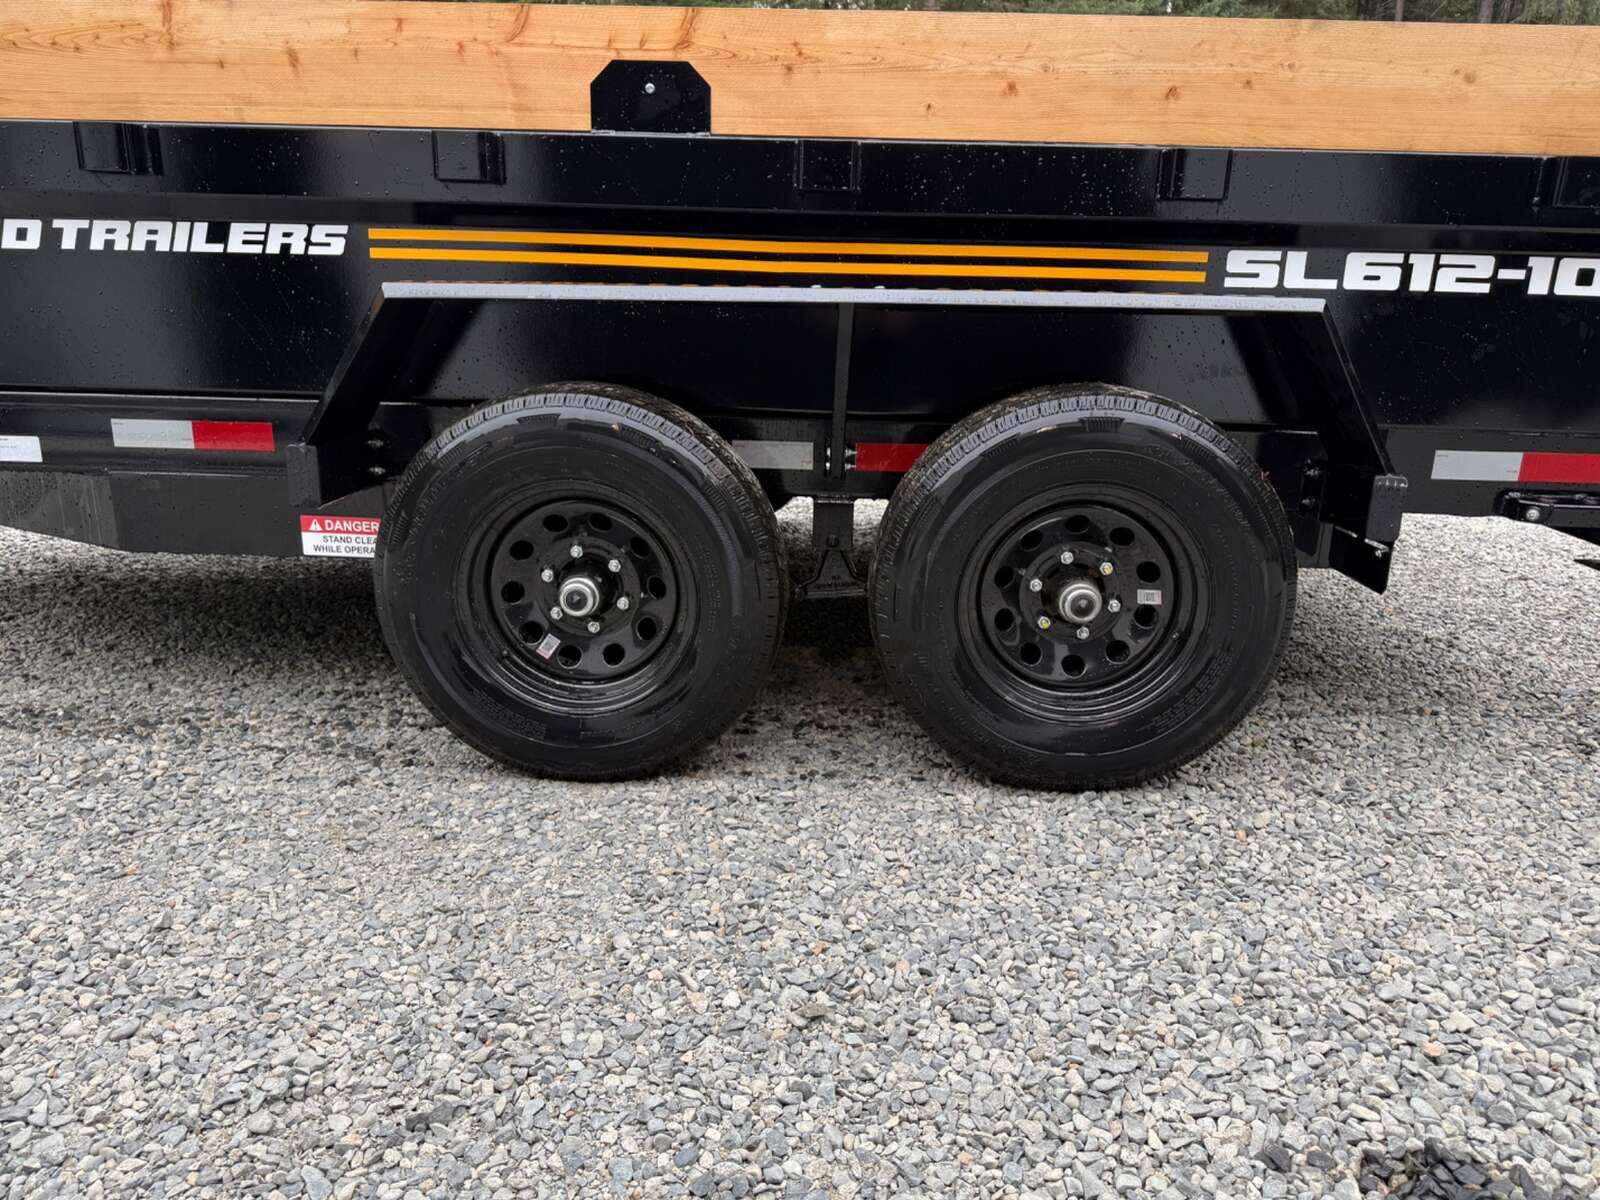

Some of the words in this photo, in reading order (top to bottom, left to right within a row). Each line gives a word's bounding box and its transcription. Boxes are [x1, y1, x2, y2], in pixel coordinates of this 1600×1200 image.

[52, 219, 348, 256] TRAILERS
[1224, 250, 1600, 296] SL612-10
[325, 520, 379, 532] DANGER
[323, 535, 352, 544] STAND
[313, 545, 342, 553] WHILE
